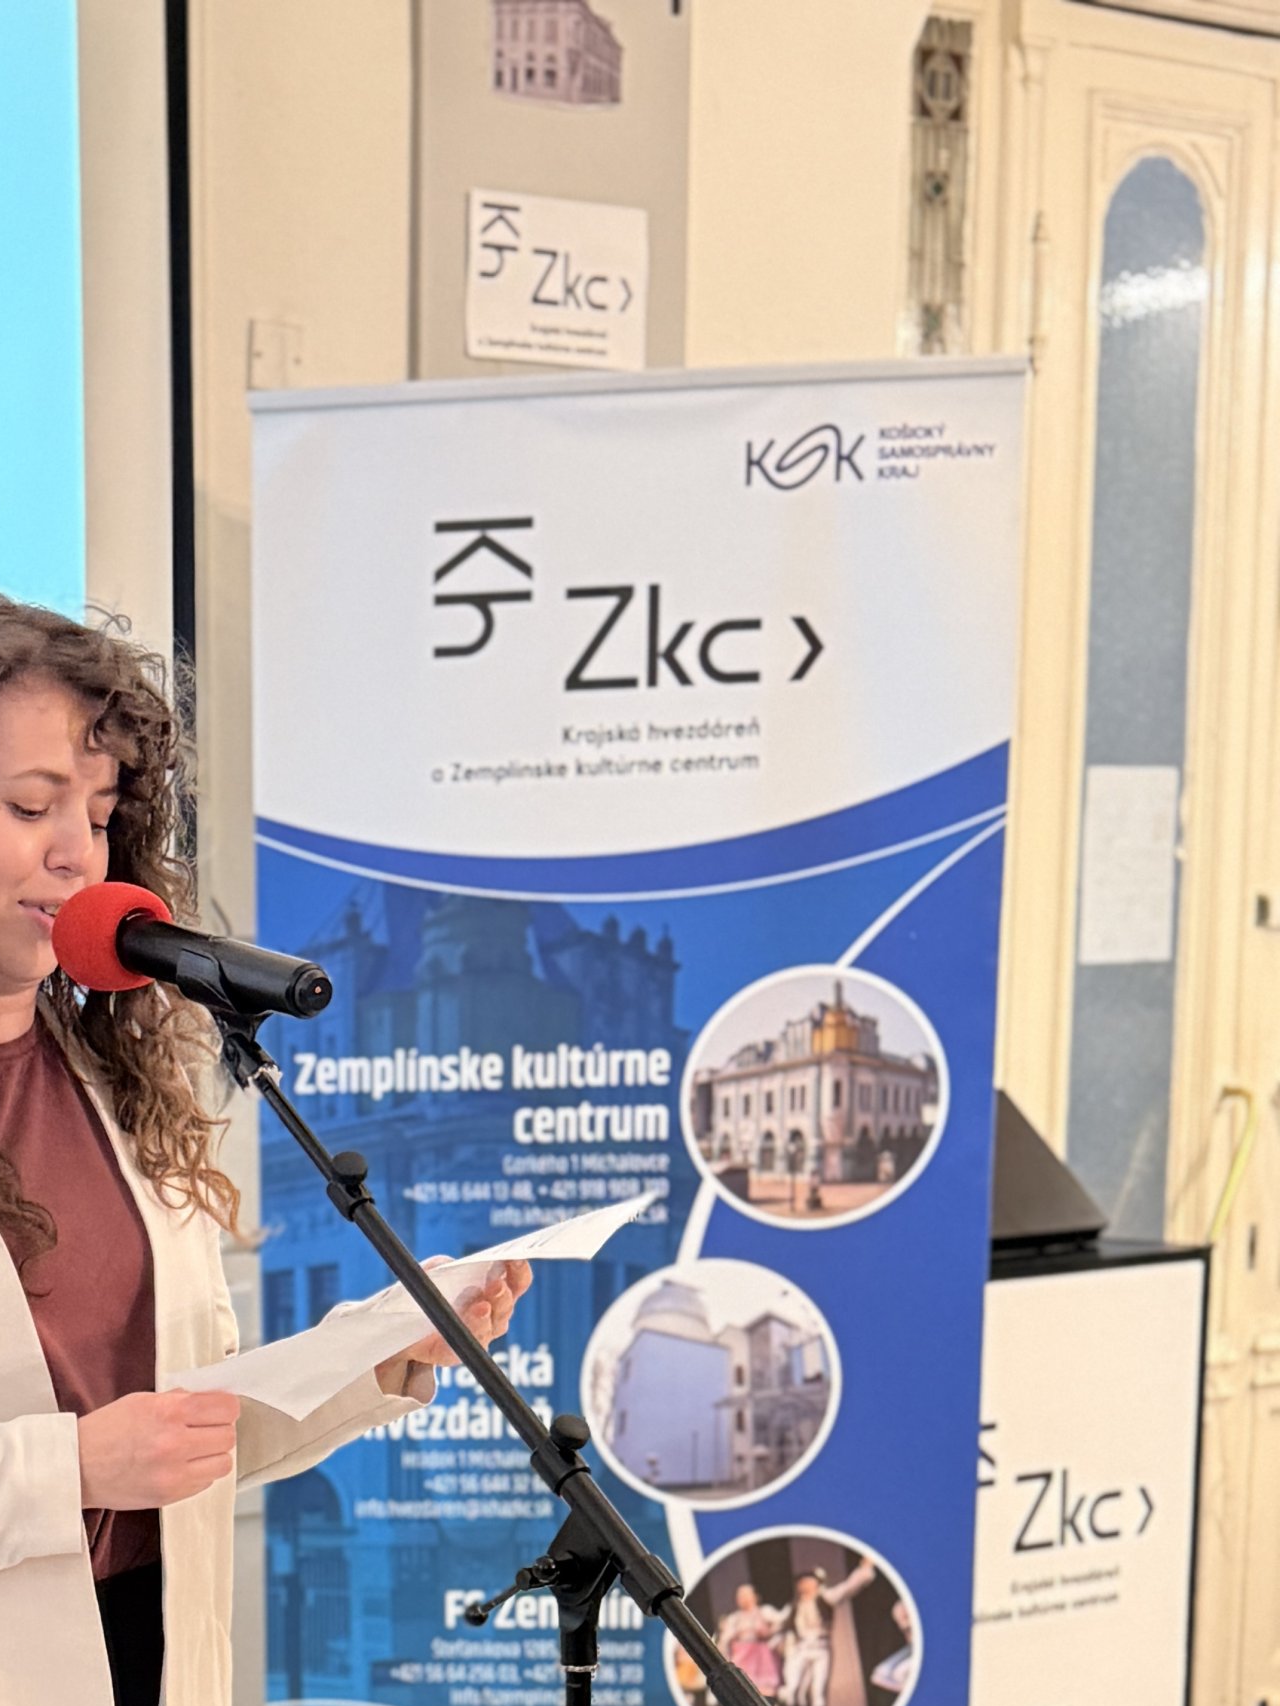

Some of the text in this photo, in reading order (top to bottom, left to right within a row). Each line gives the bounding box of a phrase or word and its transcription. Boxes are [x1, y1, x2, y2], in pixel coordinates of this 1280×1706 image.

[877, 465, 920, 480] KRAJ
[562, 717, 761, 749] Krajská hvezdáreň
[451, 762, 568, 785] Zemplínske
[575, 754, 663, 777] kultúrne
[670, 753, 760, 772] centrum
[292, 1041, 672, 1101] Zemplínske kultúrne
[512, 1100, 670, 1144] centrum
